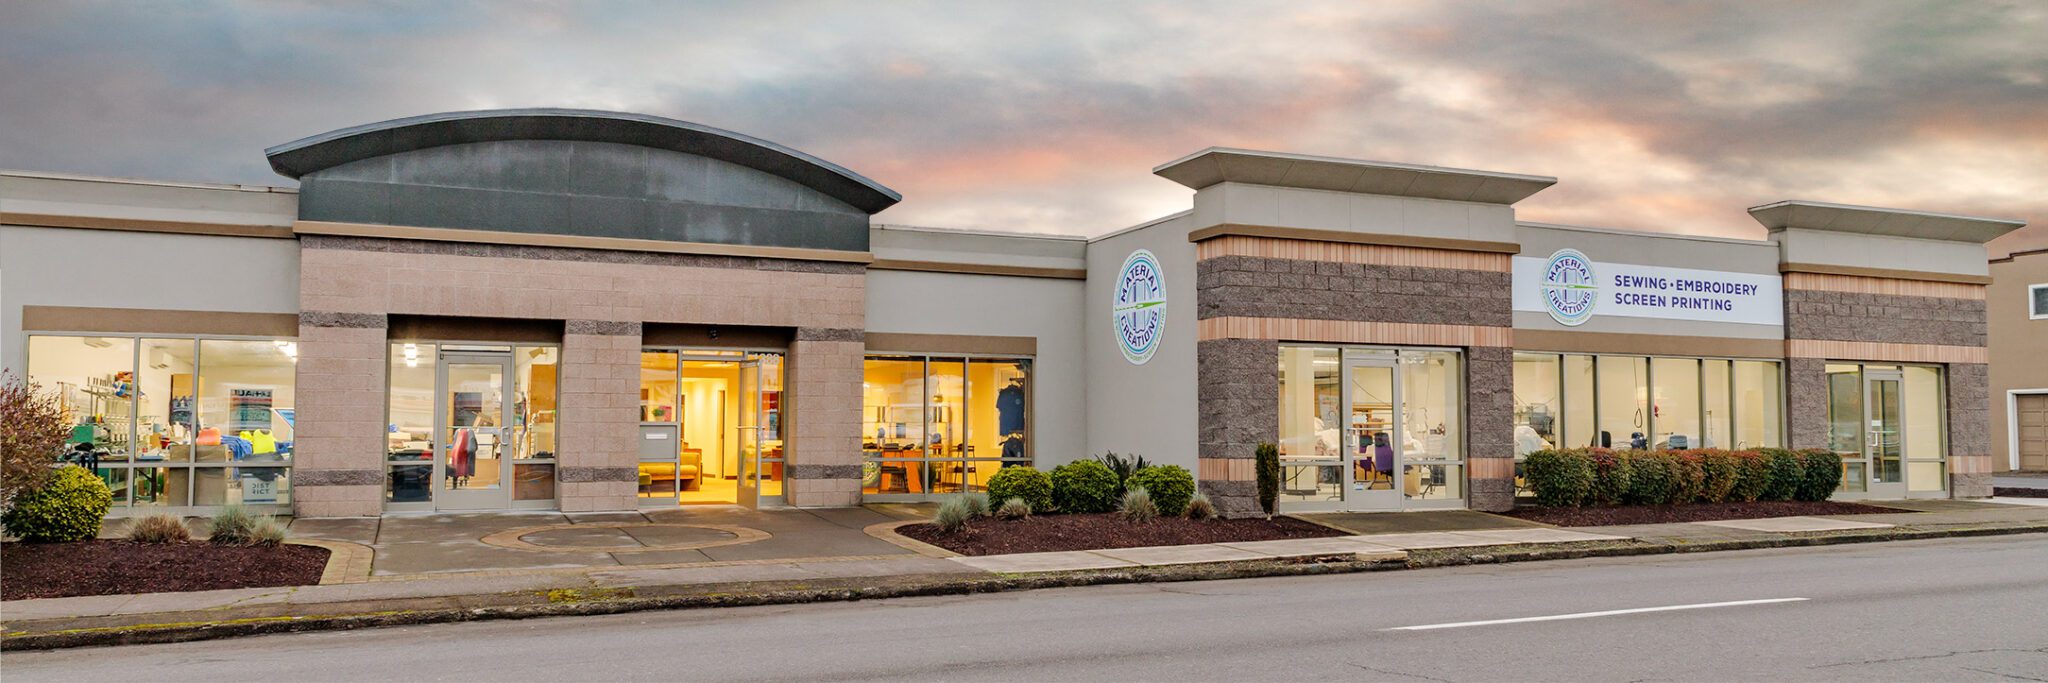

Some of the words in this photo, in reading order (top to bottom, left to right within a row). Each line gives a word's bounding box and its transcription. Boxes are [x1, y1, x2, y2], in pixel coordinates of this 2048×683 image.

[1549, 258, 1590, 282] MATERIAL
[1120, 264, 1158, 302] MATERIAL
[1615, 274, 1667, 290] SEWING
[1676, 279, 1758, 296] EMBROIDERY
[1549, 289, 1591, 313] CREATIONS
[1615, 292, 1667, 307] SCREEN
[1671, 296, 1732, 311] PRINTING
[1120, 310, 1158, 347] CREATIONS
